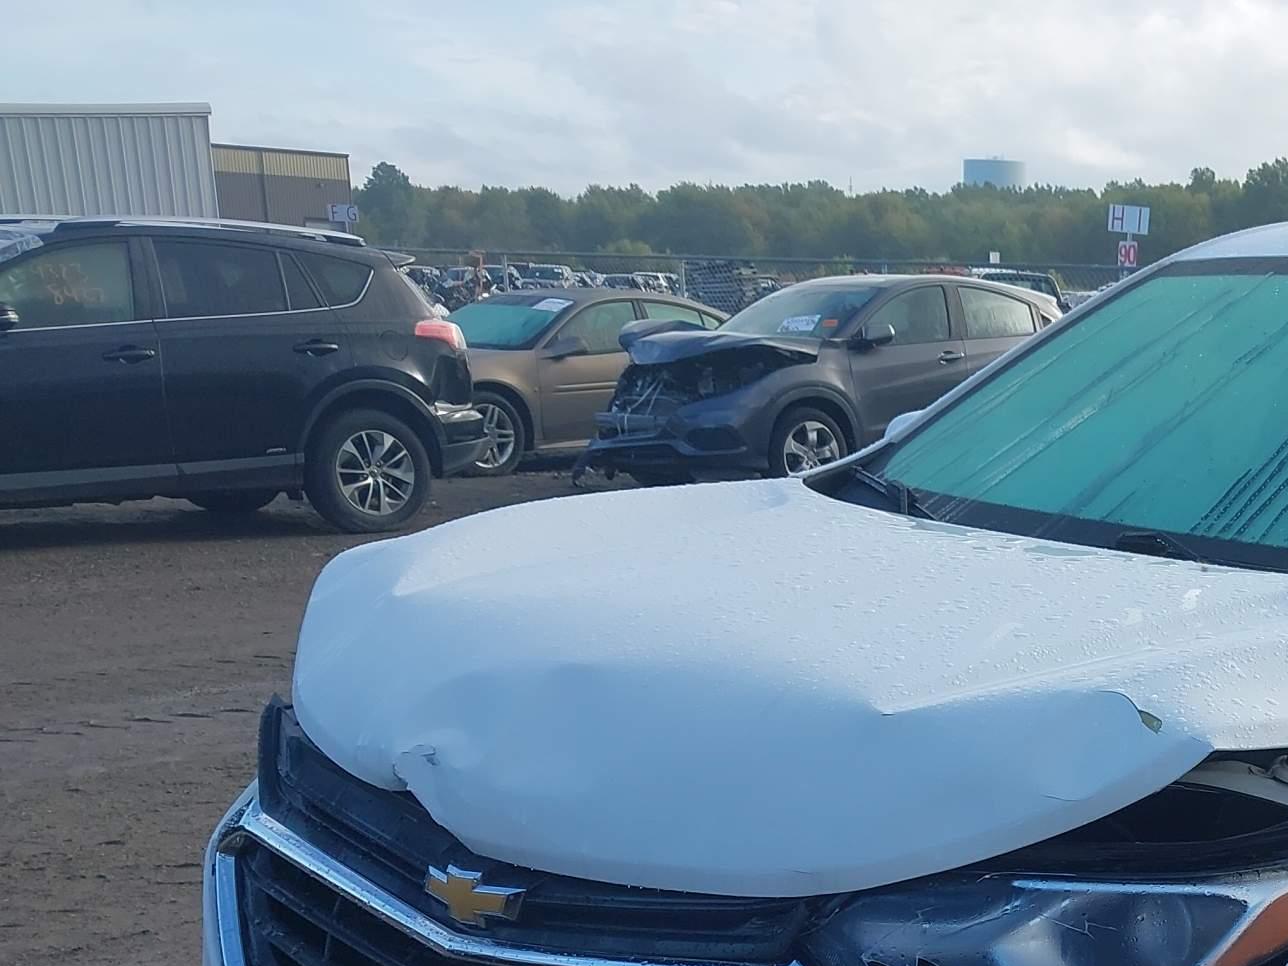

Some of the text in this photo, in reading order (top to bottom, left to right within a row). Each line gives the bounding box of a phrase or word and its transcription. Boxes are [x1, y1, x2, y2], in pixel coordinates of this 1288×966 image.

[331, 204, 357, 221] F G
[1112, 206, 1124, 231] H
[1119, 244, 1136, 265] 90
